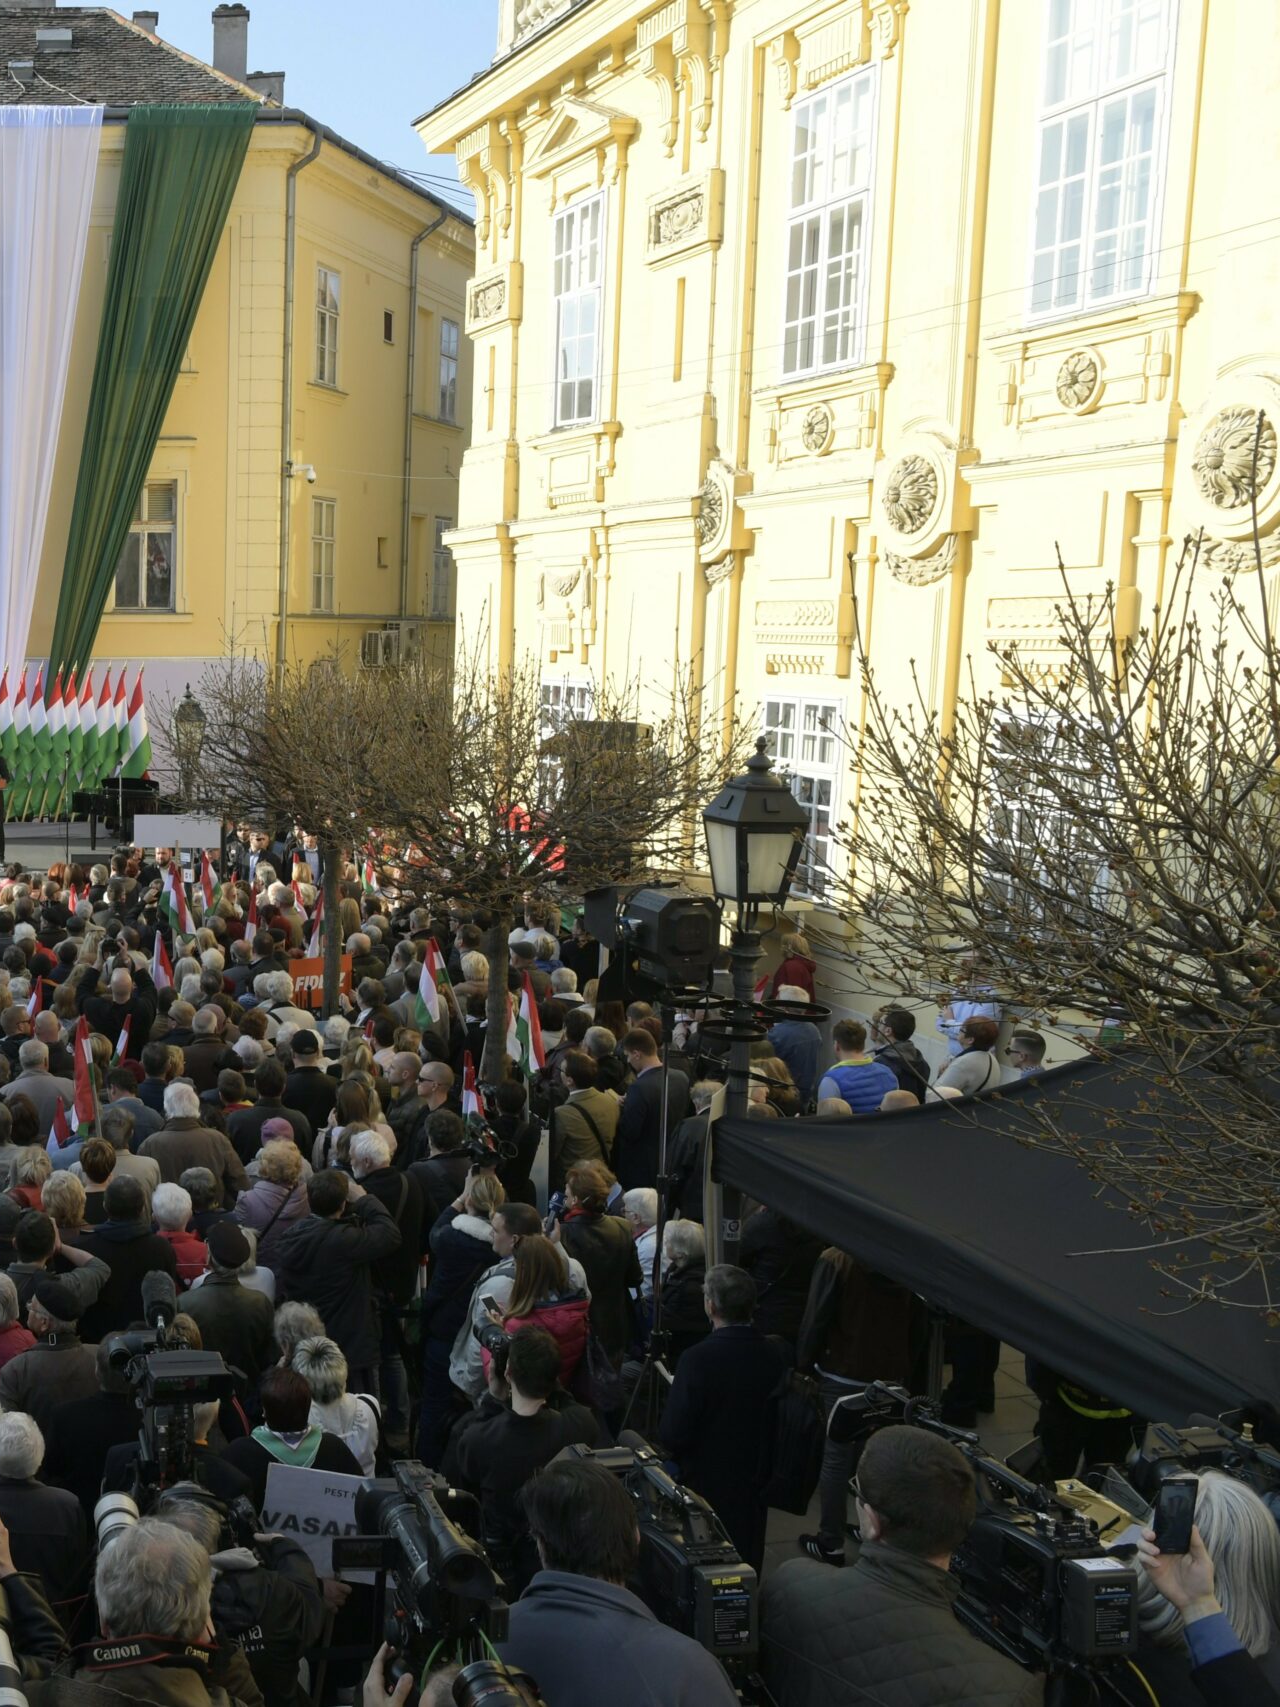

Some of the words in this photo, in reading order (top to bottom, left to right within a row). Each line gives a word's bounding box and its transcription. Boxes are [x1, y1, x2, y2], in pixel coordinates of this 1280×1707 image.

[295, 972, 346, 992] FIDZ
[324, 1487, 350, 1499] PEST
[93, 1643, 141, 1662] Canon
